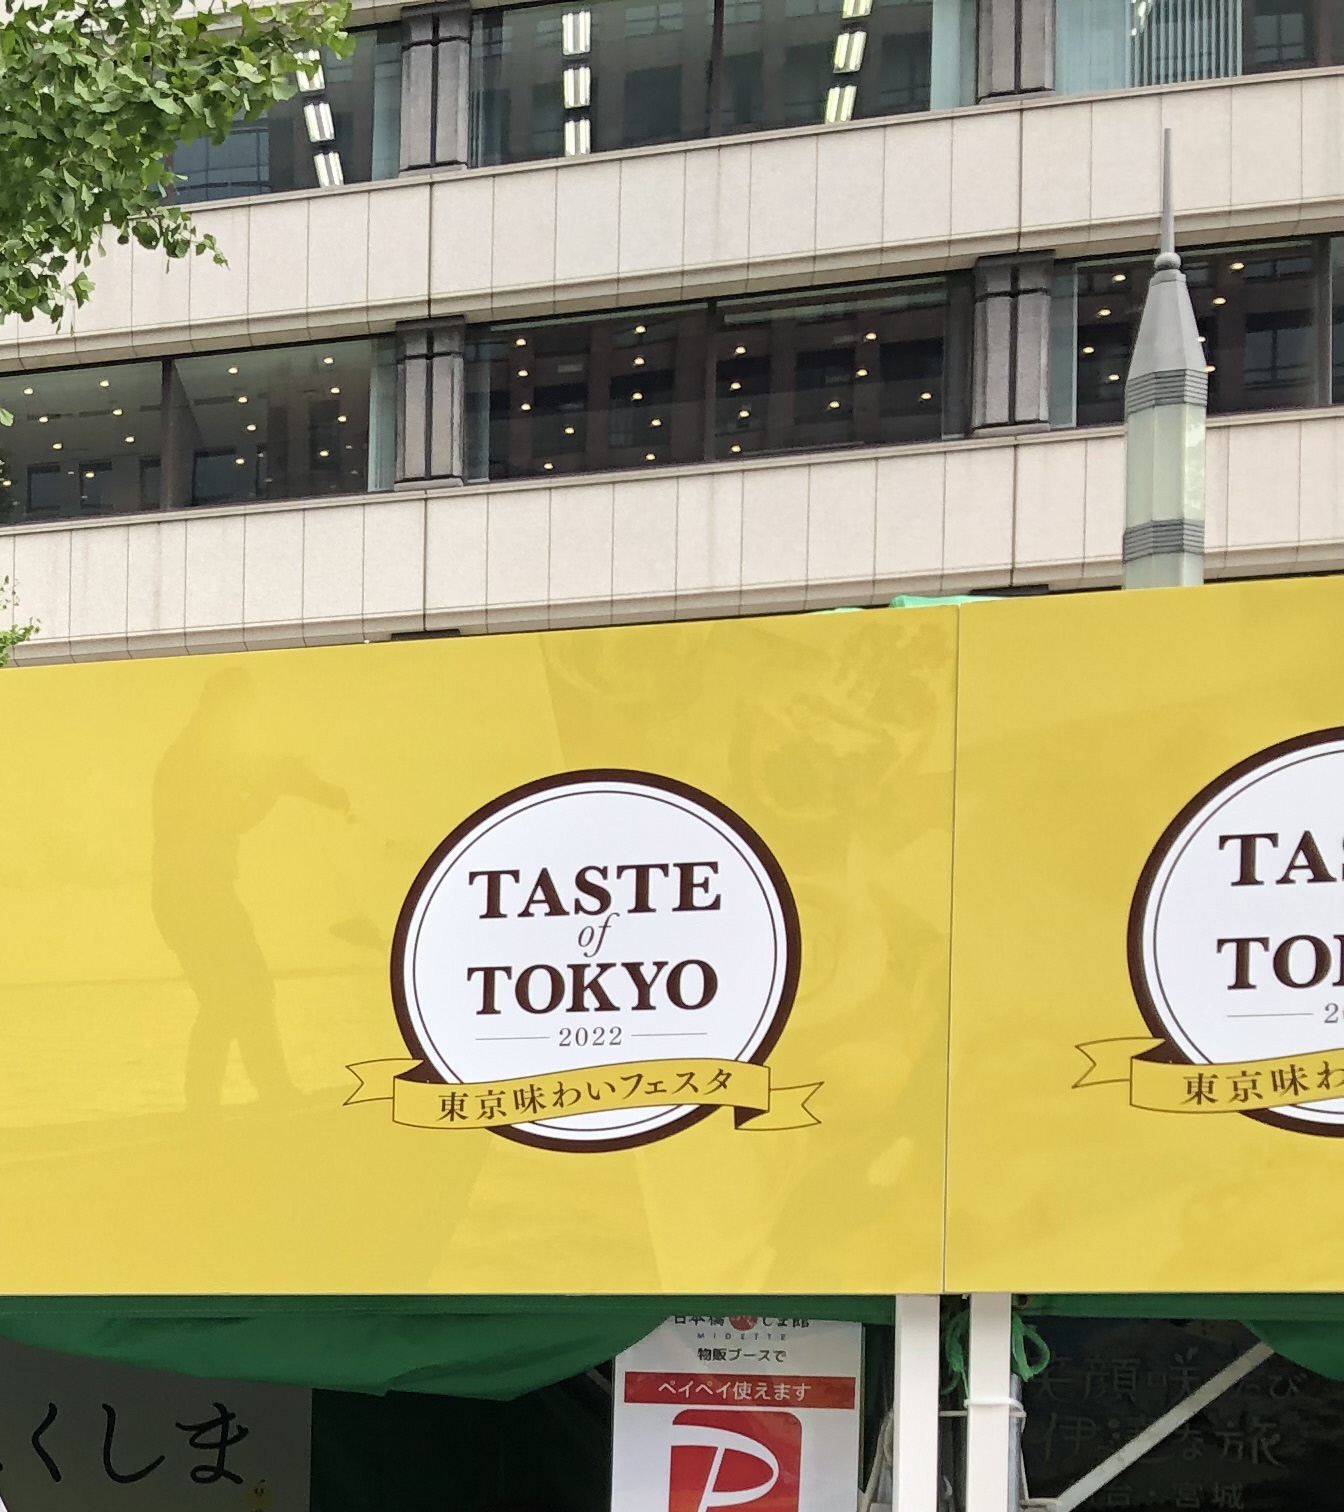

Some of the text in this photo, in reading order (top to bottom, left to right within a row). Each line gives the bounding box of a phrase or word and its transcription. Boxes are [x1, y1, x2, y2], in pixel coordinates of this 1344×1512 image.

[1219, 830, 1344, 886] TA
[468, 862, 722, 919] TASTE
[578, 912, 622, 957] of
[1216, 934, 1344, 990] TO
[467, 959, 718, 1016] TOKYO
[558, 1026, 623, 1047] 2022
[437, 1068, 735, 1123] 東京味わいフェスタ
[697, 1332, 786, 1340] MIDETTE
[698, 1348, 787, 1362] 物販ブースで
[658, 1381, 811, 1401] ペイペイ使えます
